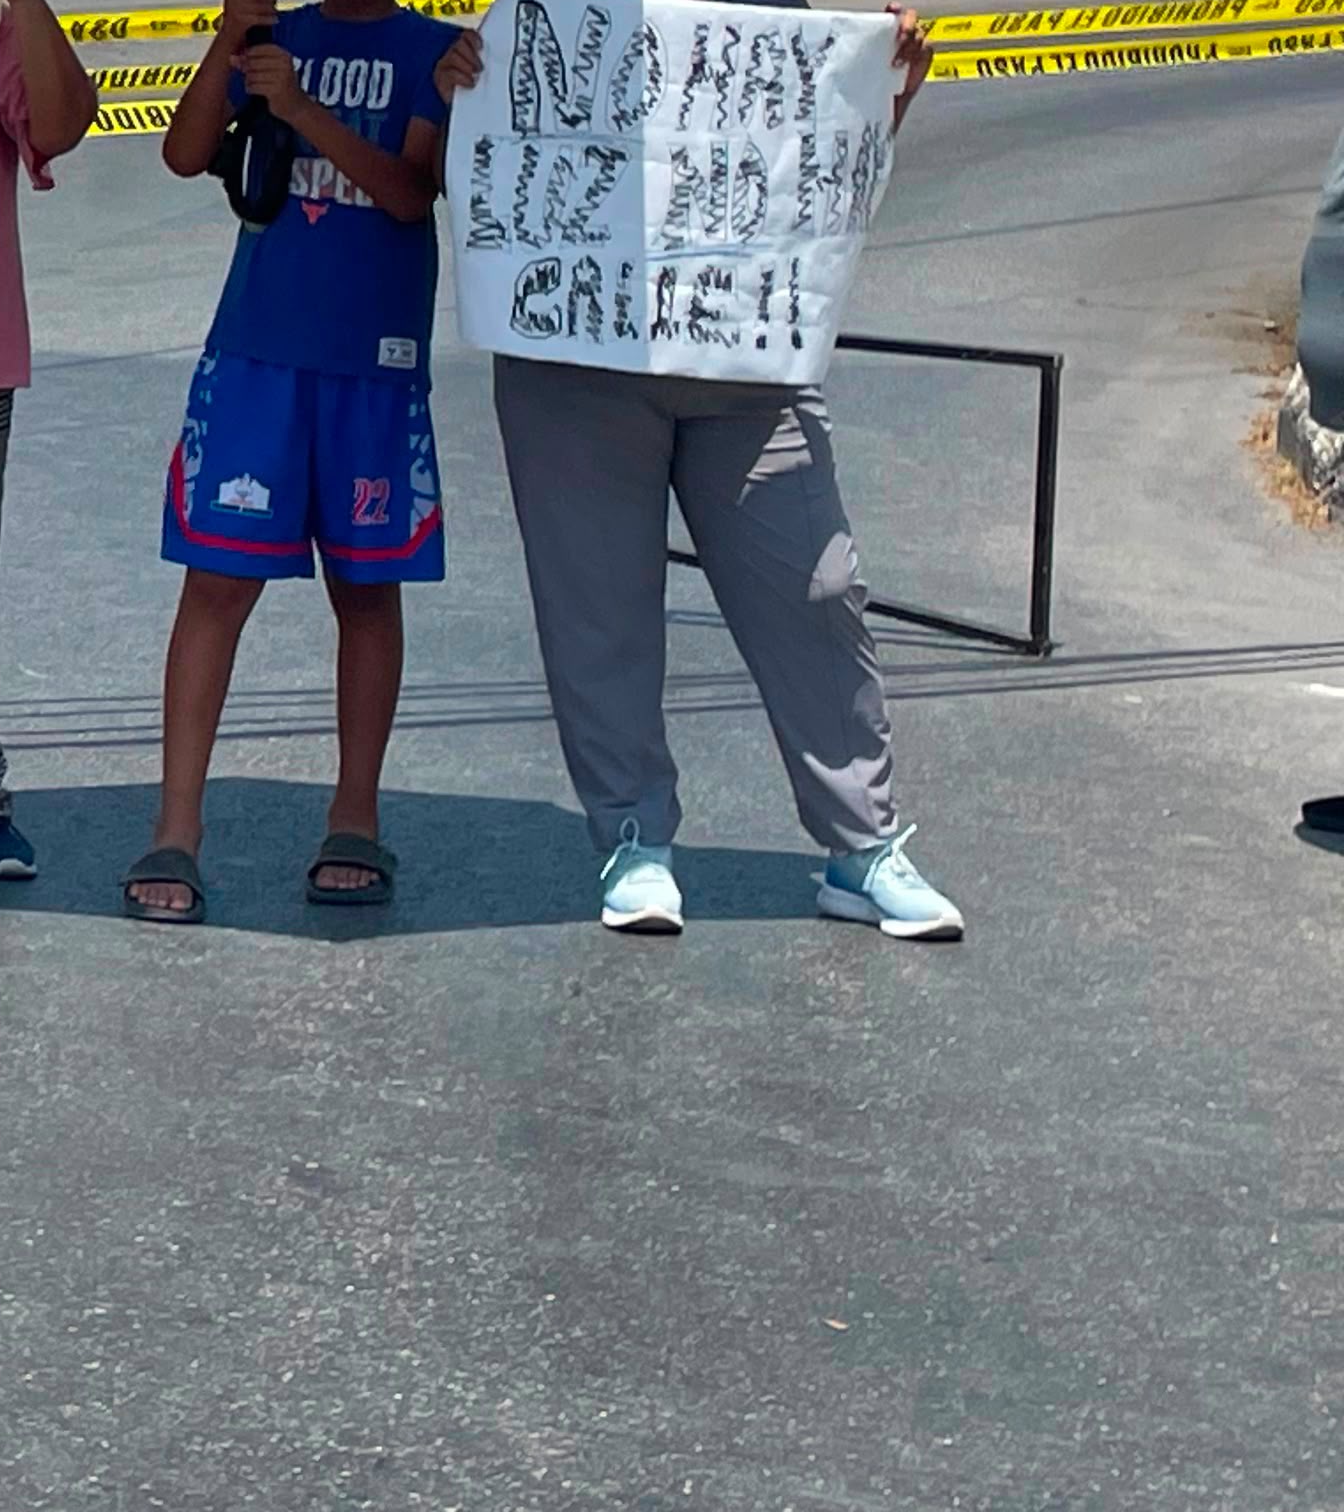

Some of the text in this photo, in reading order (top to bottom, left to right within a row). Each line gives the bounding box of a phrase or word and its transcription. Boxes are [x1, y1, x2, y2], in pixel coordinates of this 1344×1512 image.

[293, 56, 394, 111] LOOD
[677, 21, 838, 133] HAY
[652, 133, 769, 254] NO
[352, 477, 391, 526] 22
